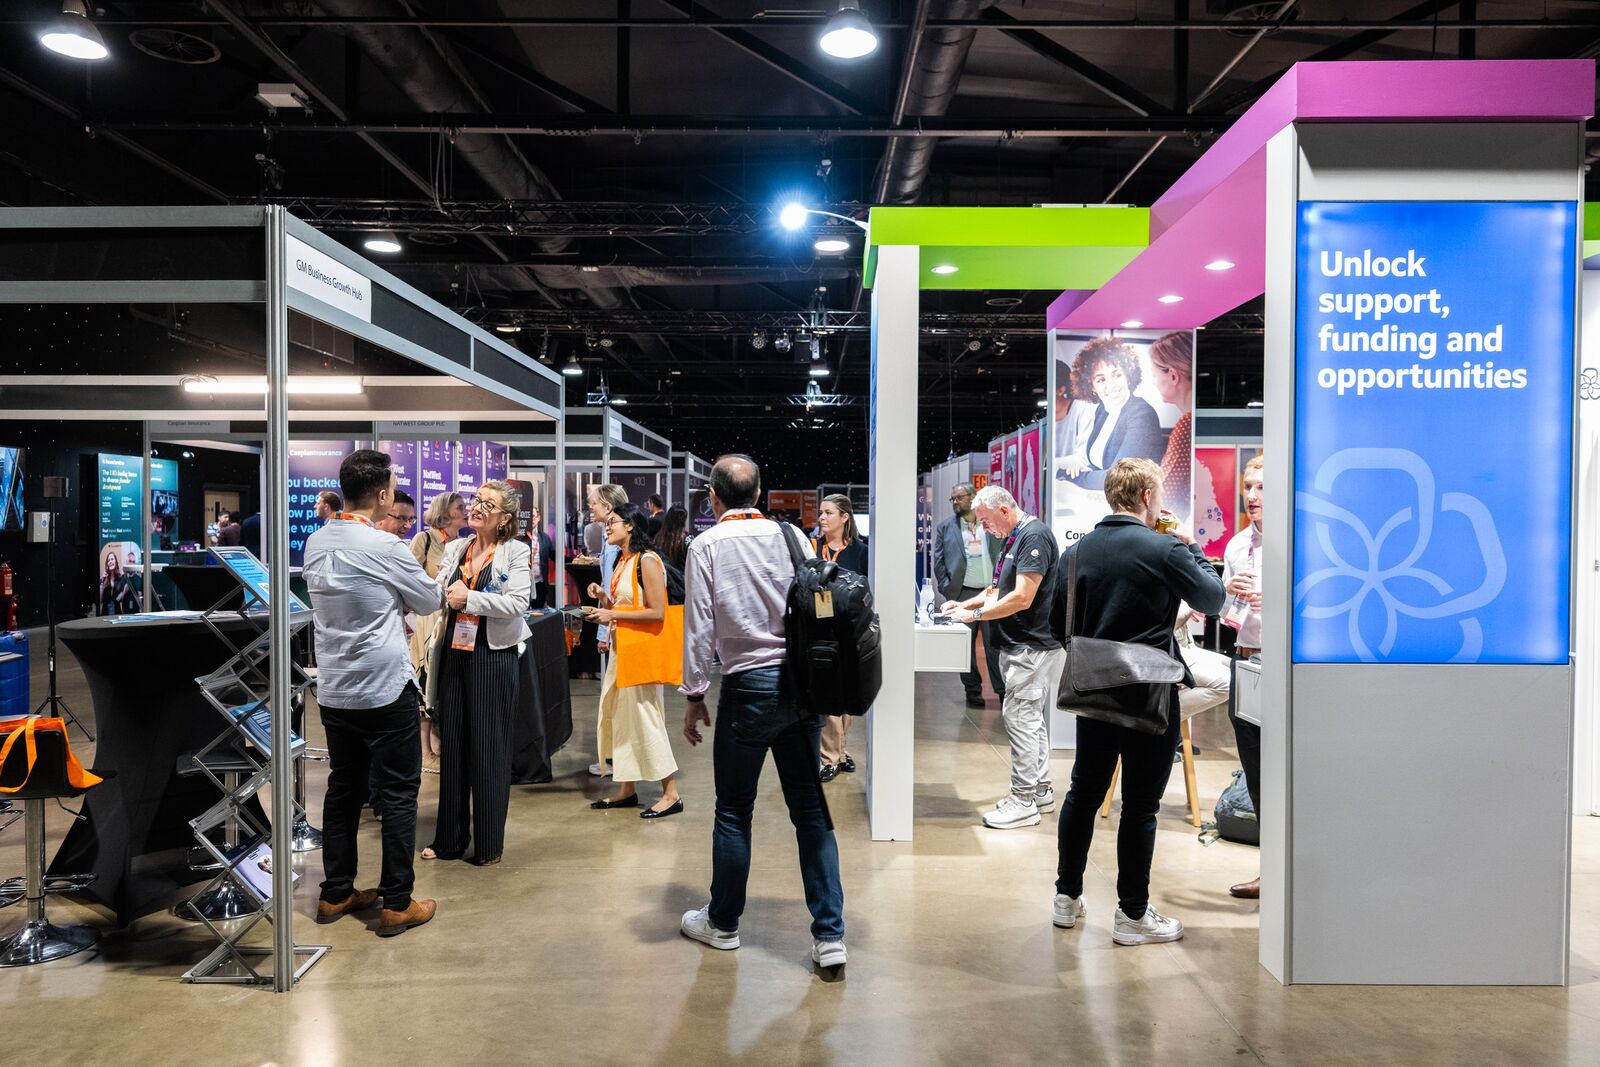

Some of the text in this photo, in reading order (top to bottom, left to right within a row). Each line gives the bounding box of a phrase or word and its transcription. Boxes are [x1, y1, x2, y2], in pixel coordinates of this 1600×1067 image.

[296, 259, 363, 301] GM Business Growth Hub
[1320, 248, 1427, 277] Unlock
[1318, 288, 1450, 320] support,
[1318, 323, 1503, 360] funding and
[1317, 361, 1528, 396] opportunities
